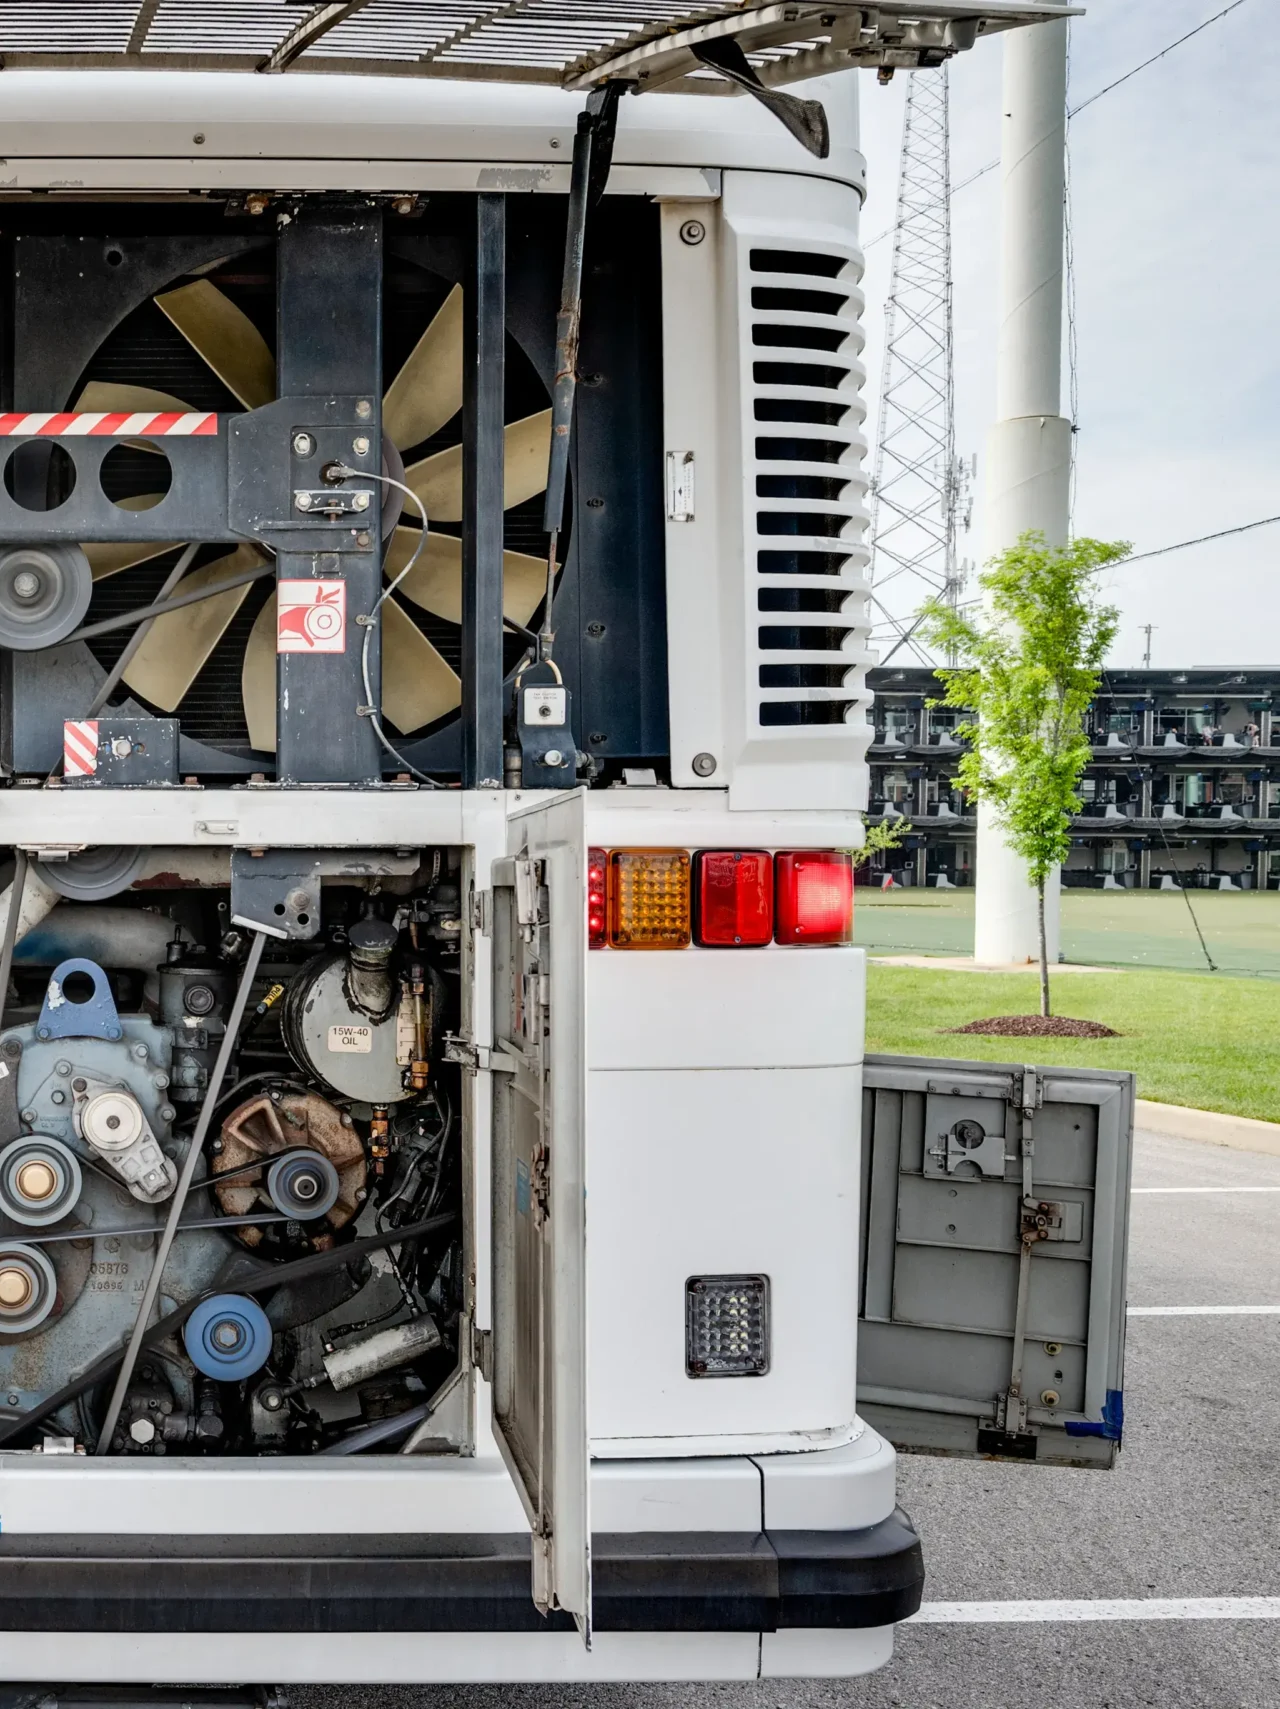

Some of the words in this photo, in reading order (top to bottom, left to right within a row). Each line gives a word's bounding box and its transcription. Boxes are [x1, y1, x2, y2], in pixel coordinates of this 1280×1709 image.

[265, 986, 281, 1002] PULL
[333, 1027, 369, 1036] 15W-40
[341, 1036, 359, 1046] OIL
